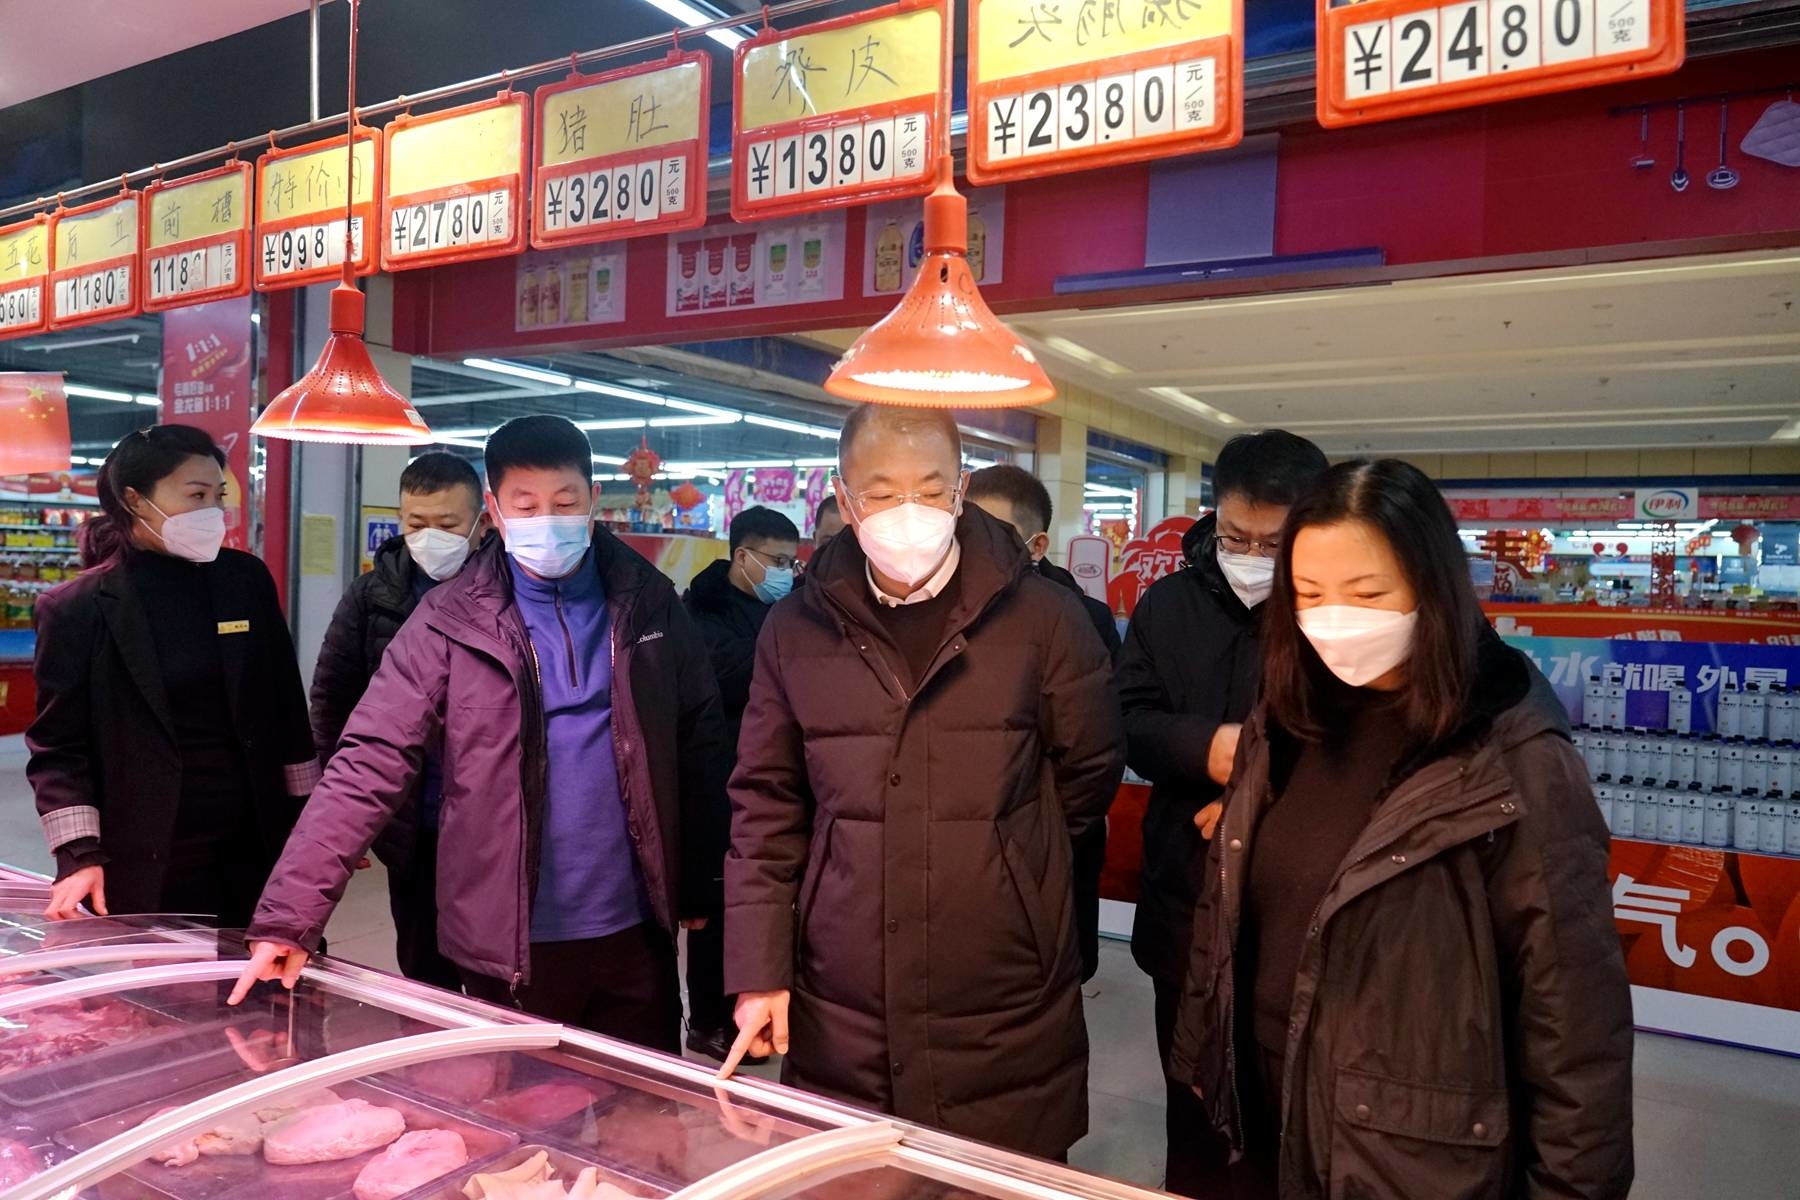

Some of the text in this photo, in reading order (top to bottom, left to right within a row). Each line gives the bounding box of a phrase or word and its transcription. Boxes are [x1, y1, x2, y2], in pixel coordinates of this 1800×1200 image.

[557, 94, 669, 155] 猪肚
[993, 76, 1166, 154] ¥23.80
[751, 129, 887, 193] ¥13.80
[394, 200, 484, 250] ¥27.80
[547, 168, 655, 226] ¥32.80
